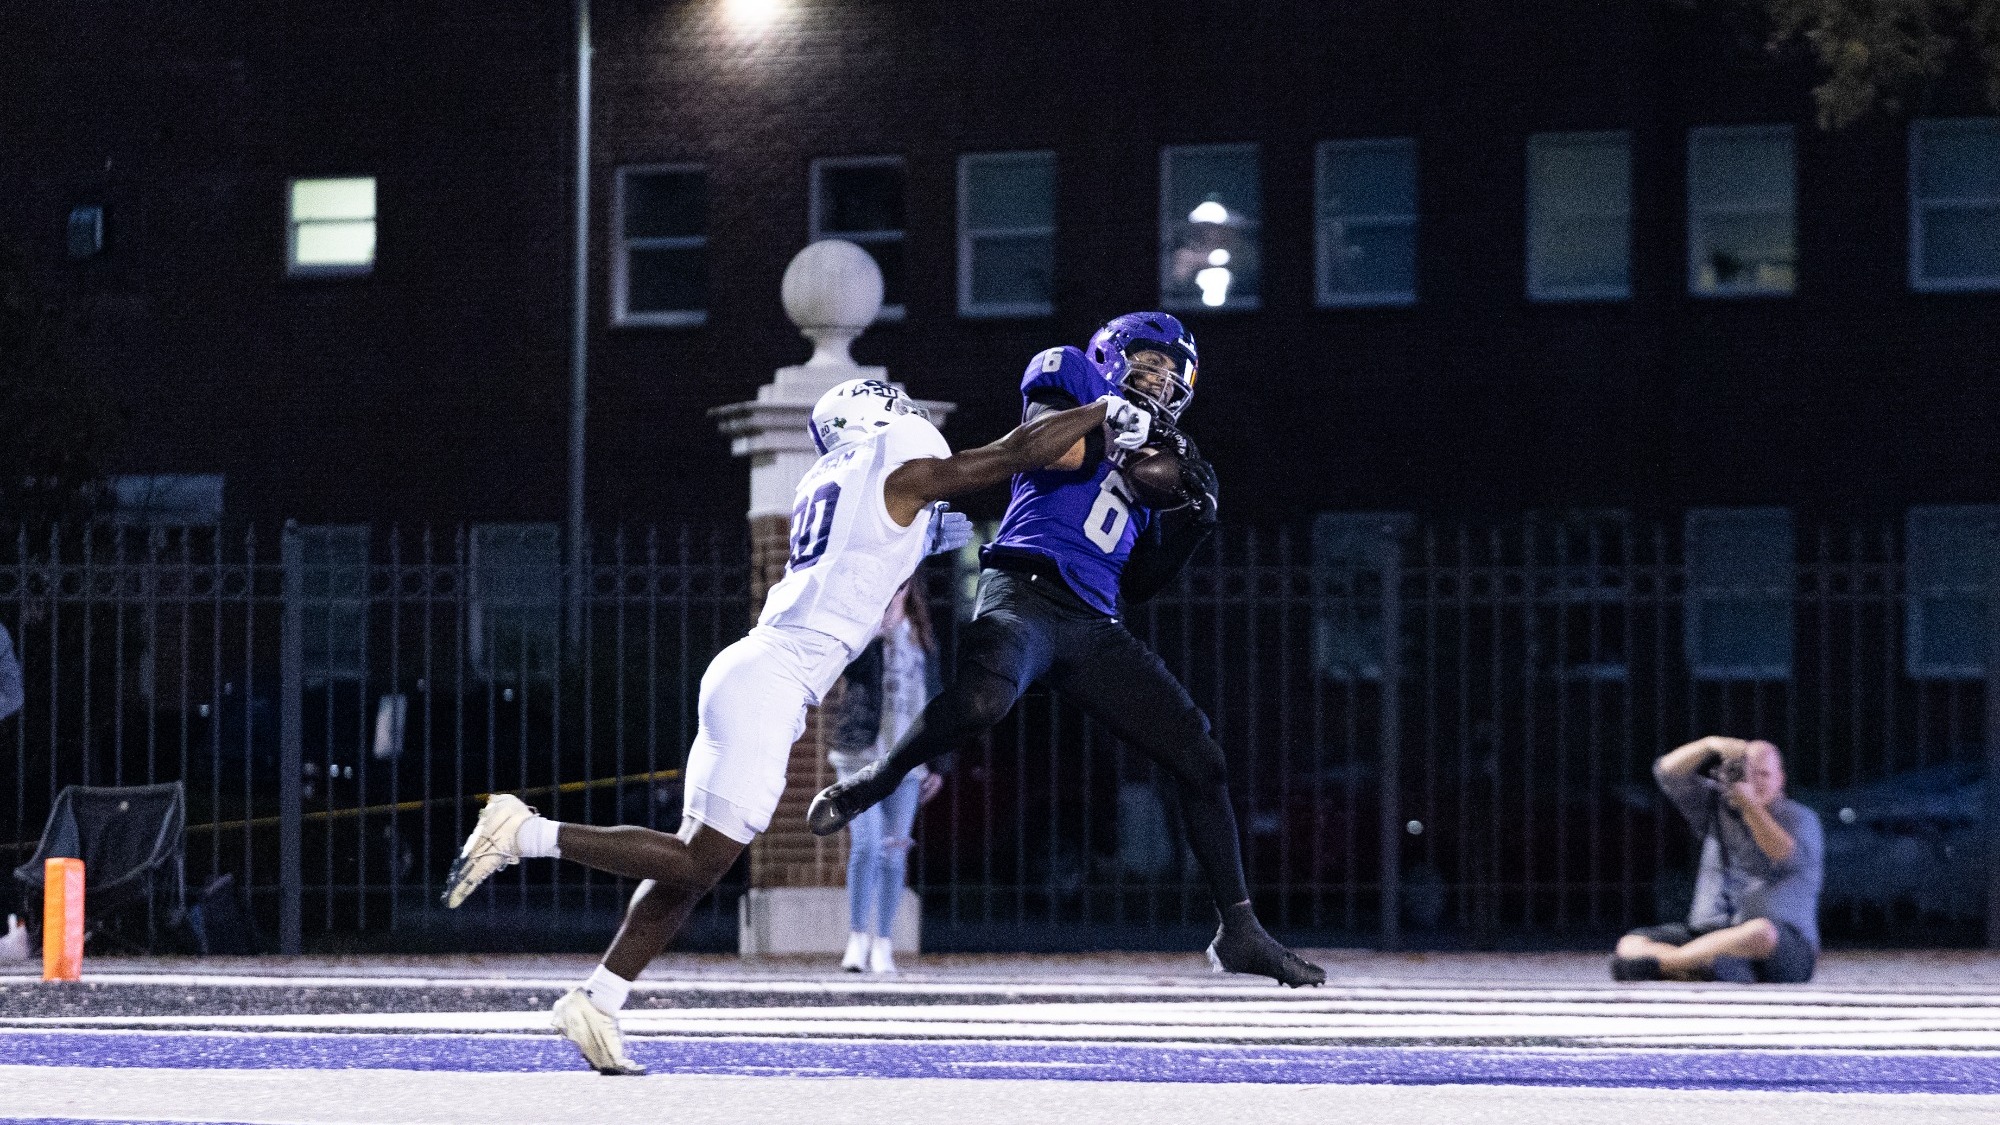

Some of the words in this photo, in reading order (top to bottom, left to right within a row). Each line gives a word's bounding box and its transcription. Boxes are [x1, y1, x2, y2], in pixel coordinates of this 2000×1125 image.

[1041, 346, 1064, 373] 6
[820, 424, 830, 437] 20
[790, 480, 841, 573] 20
[1083, 470, 1133, 554] 6
